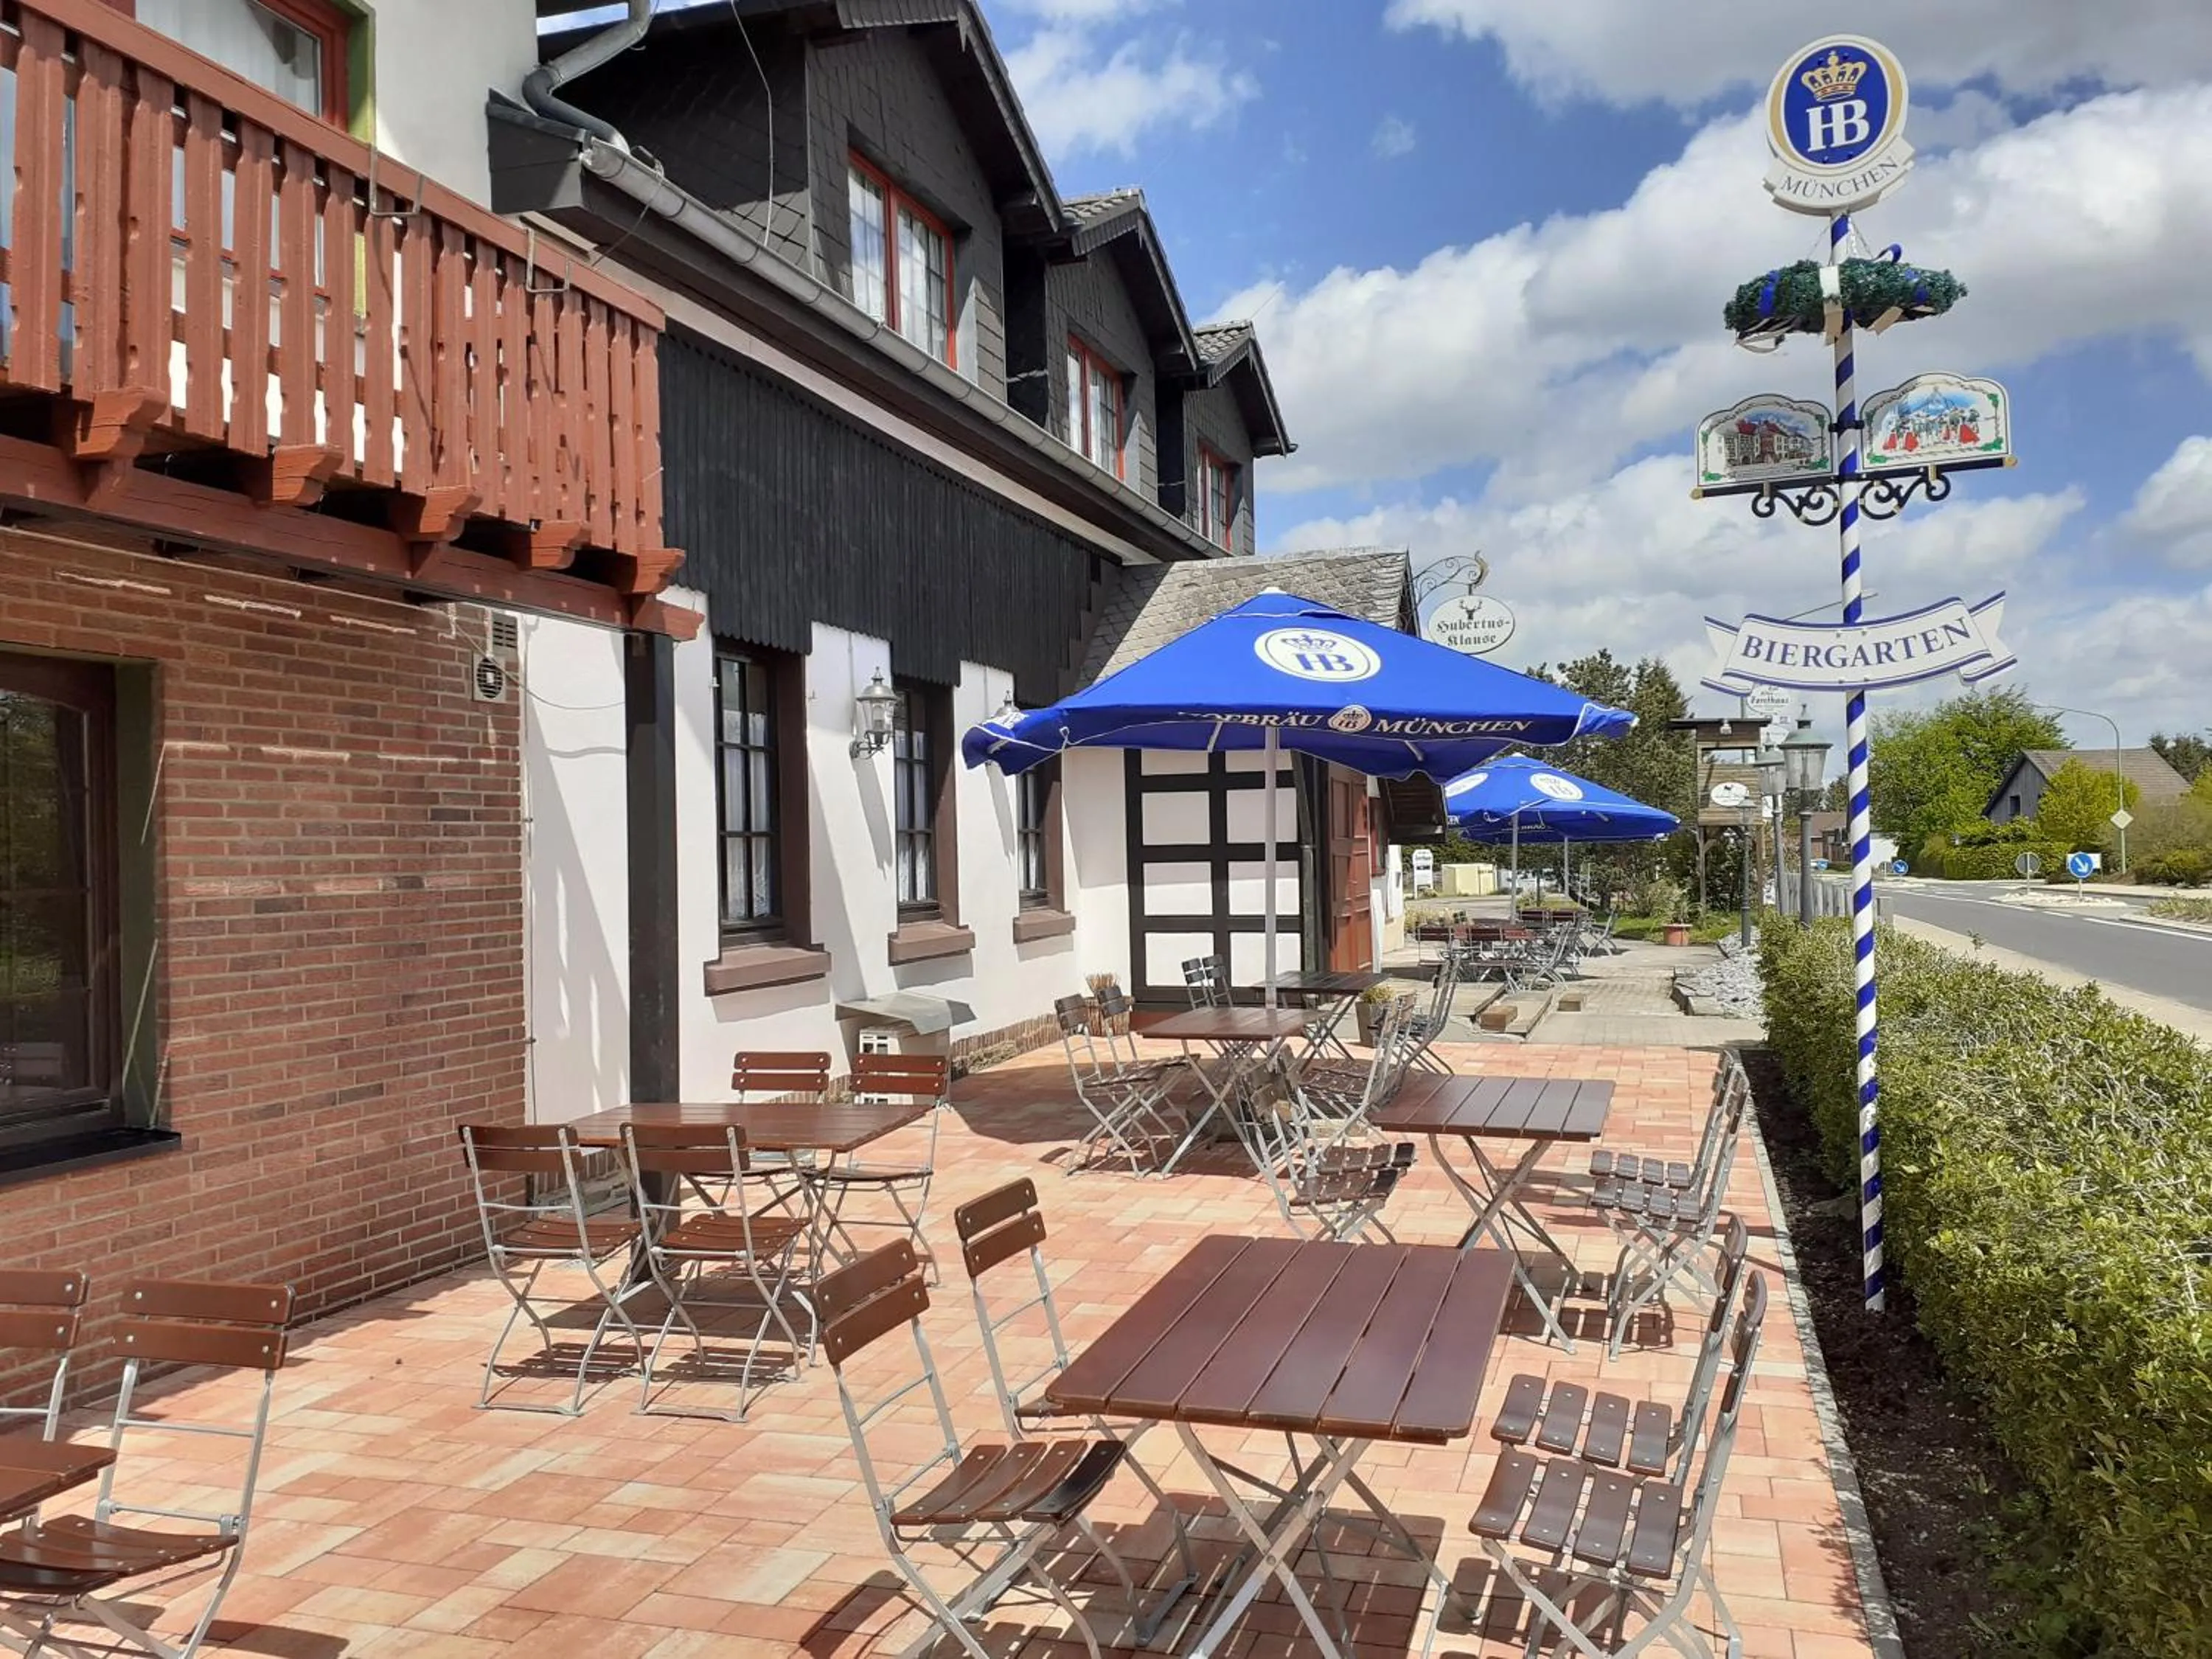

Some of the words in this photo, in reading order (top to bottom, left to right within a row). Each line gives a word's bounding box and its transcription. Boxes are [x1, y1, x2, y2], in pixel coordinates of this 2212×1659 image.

[1806, 99, 1870, 152] HB
[1780, 156, 1898, 199] MÜNCHEN
[1293, 653, 1355, 672] HB
[1741, 616, 1971, 668] BIERGARTEN
[1371, 710, 1534, 734] MÜNCHEN
